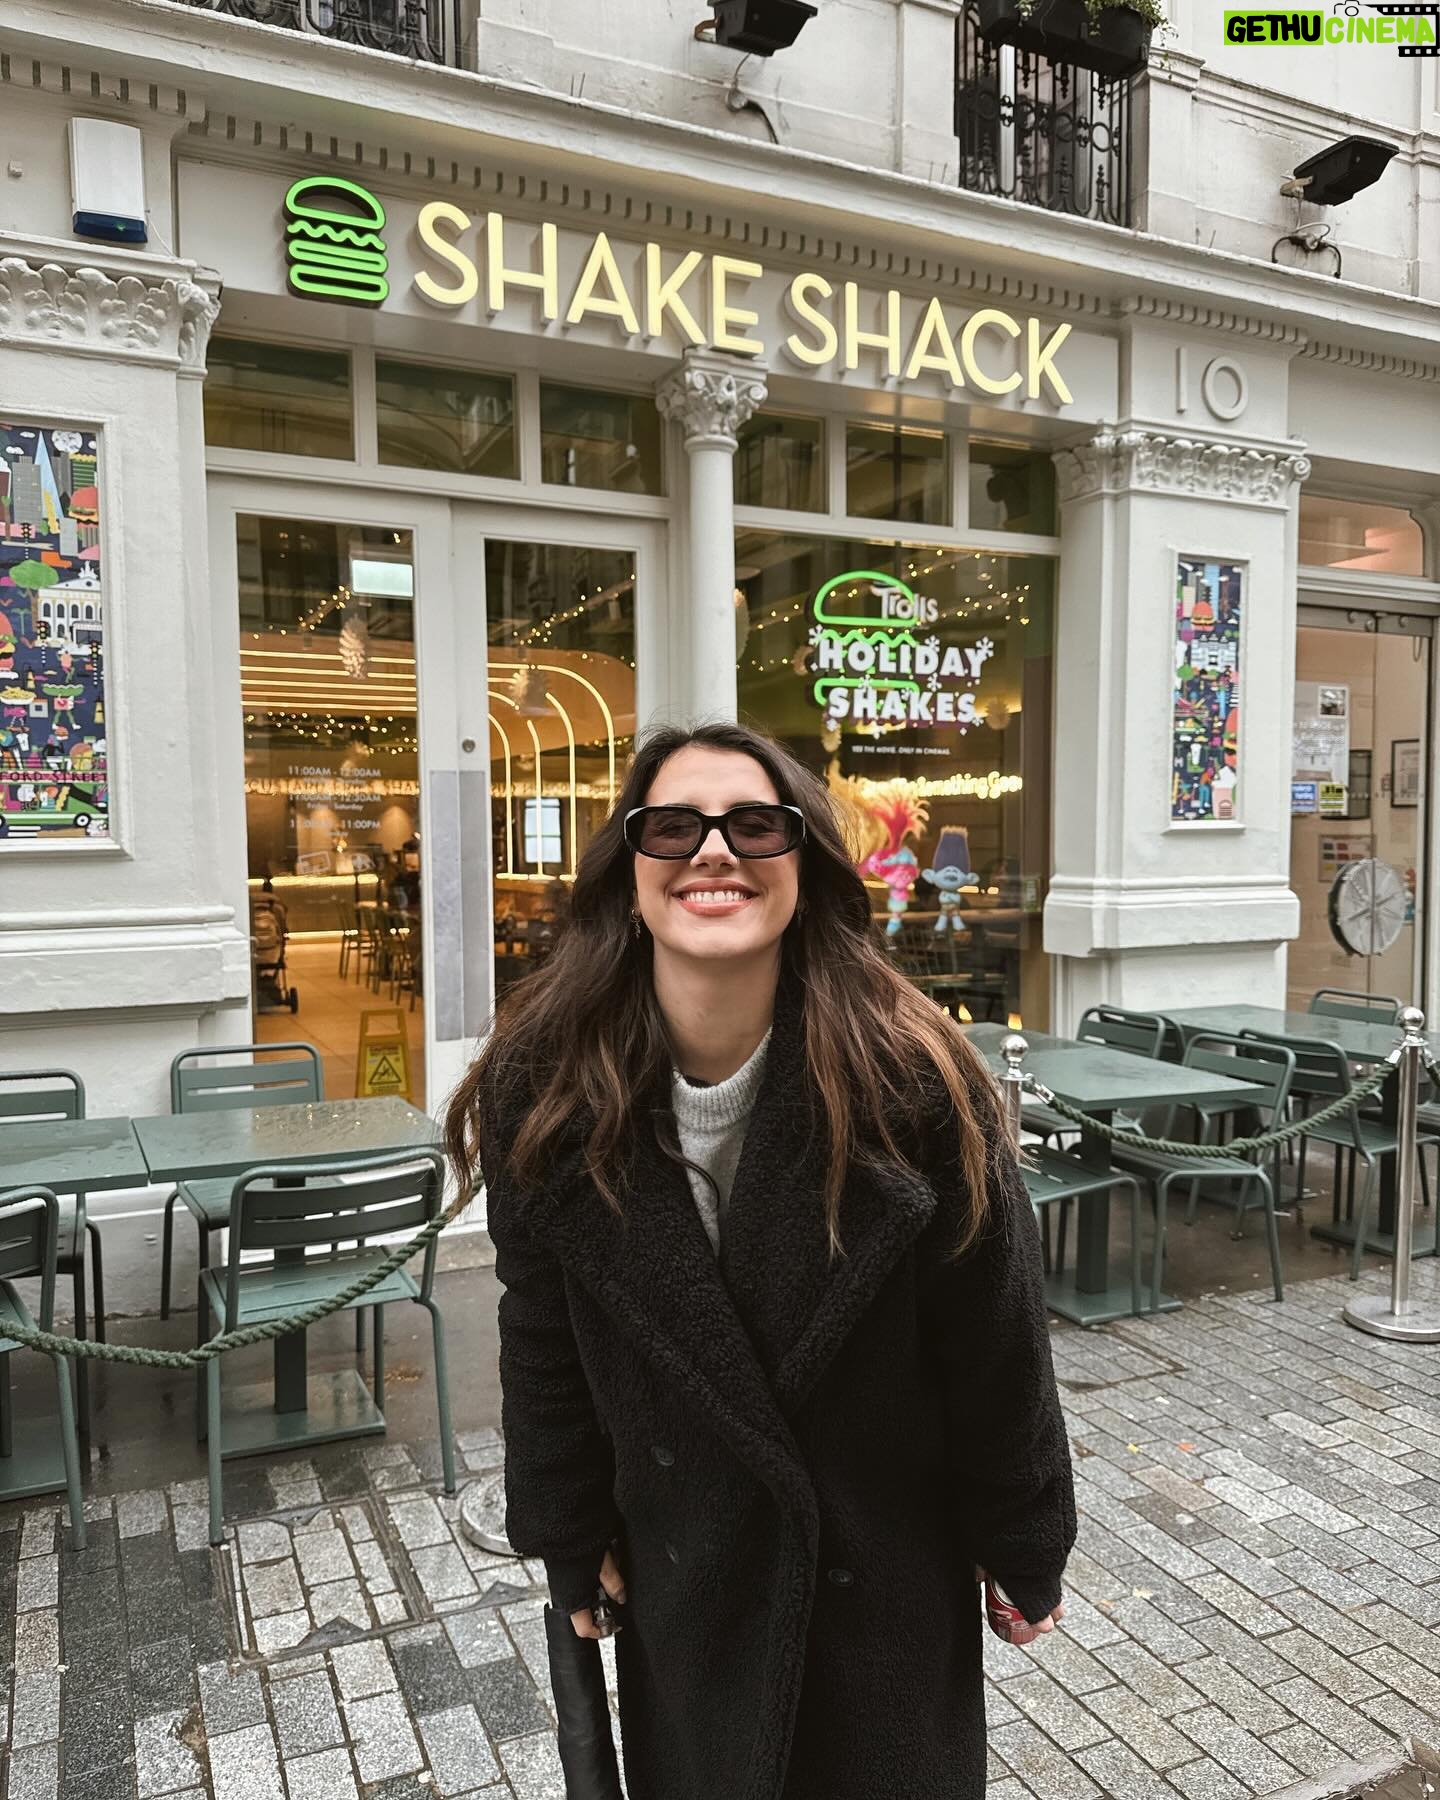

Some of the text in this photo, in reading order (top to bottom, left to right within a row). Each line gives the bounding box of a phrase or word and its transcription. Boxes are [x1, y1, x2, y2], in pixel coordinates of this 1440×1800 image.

[413, 201, 1074, 405] SHAKE SHACK
[819, 640, 986, 678] HOLIDAY
[828, 687, 976, 724] SHAKES
